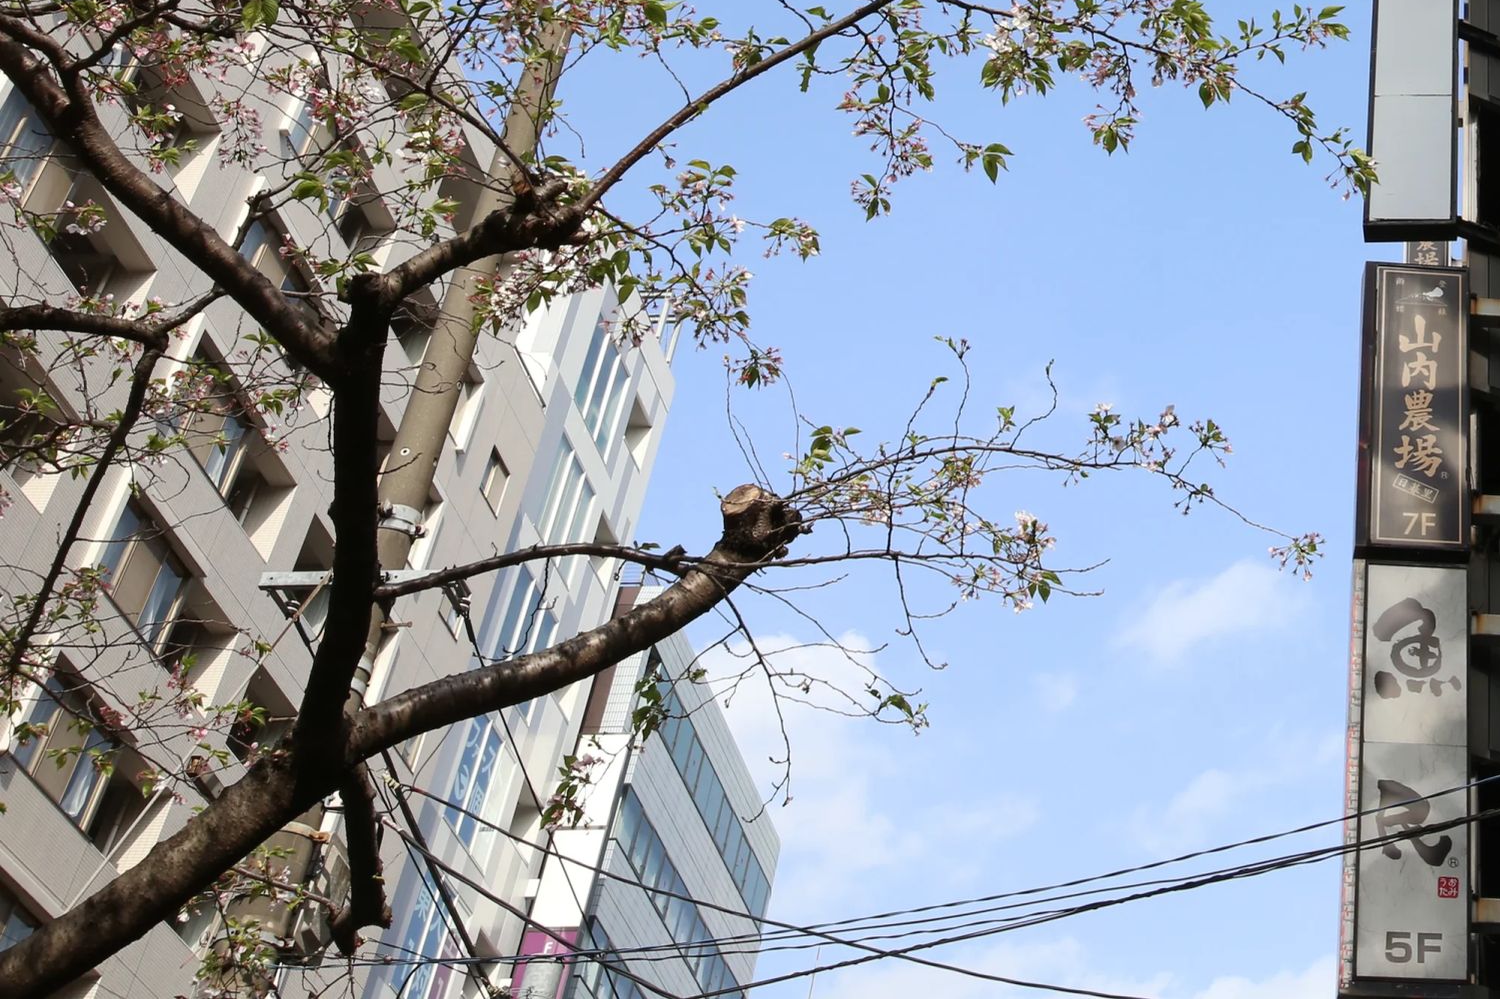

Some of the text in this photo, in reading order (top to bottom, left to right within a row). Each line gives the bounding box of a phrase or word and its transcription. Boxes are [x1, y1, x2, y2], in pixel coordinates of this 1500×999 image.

[1394, 315, 1442, 477] 山内農場
[1402, 512, 1436, 536] 7F
[1373, 597, 1461, 867] 魚民
[1385, 931, 1443, 964] 5F
